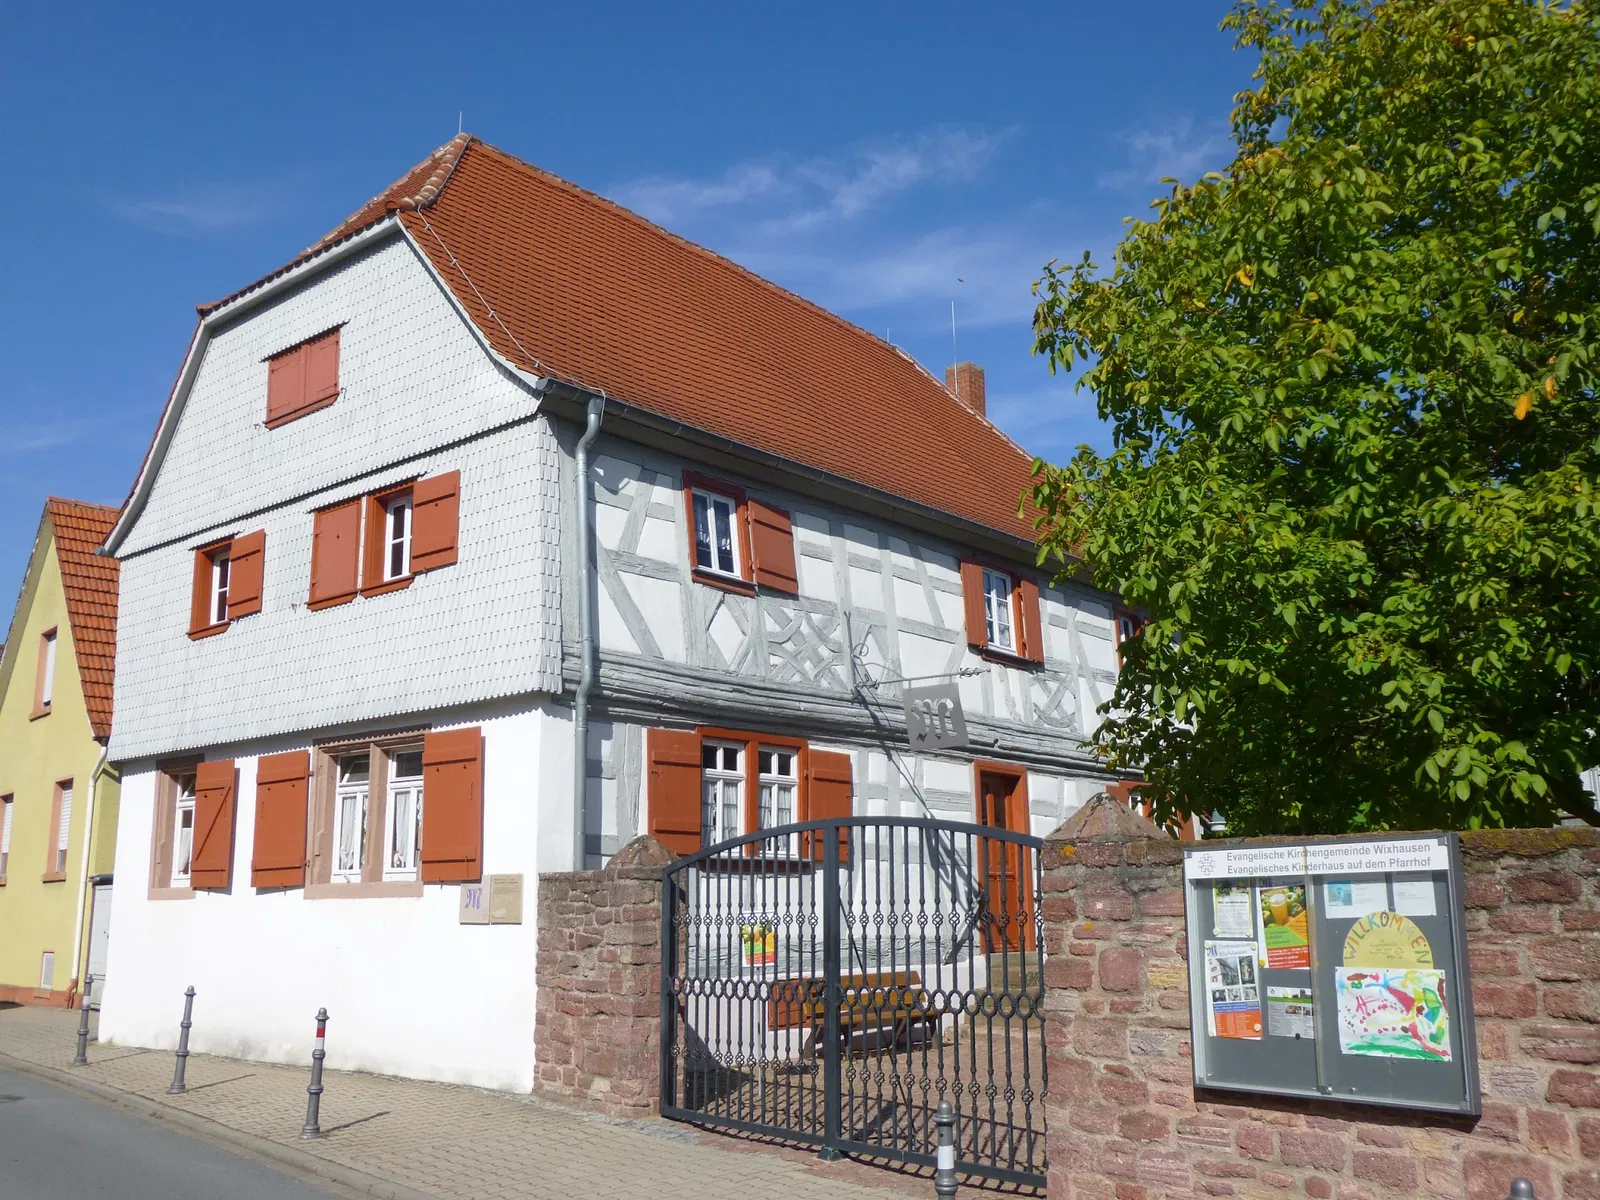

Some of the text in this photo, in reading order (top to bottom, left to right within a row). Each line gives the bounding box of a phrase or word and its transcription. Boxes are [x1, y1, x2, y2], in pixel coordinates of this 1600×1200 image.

[1226, 844, 1431, 863] Evangelische Kirchengemeinde Wixhausen
[1227, 857, 1431, 875] Evangelisches Kinderhaus auf dem Pfarrhof
[1343, 911, 1432, 964] WILLKOMMEN
